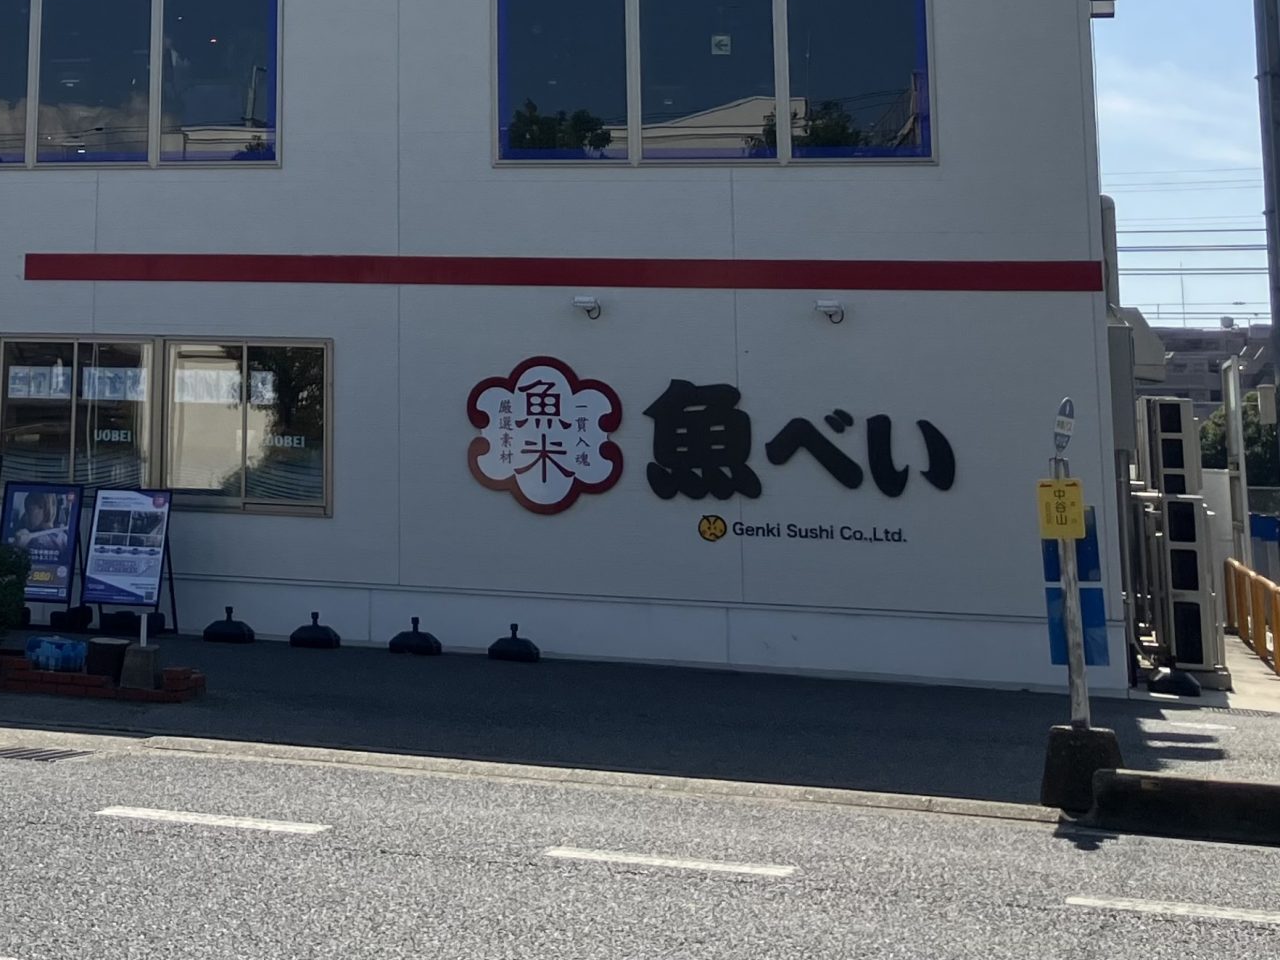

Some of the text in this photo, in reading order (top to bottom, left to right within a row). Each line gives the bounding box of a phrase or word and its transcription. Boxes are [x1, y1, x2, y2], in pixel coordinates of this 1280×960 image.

[94, 428, 132, 442] UOBEI
[498, 398, 515, 465] 厳選素材
[574, 404, 591, 468] 一貫入魂
[642, 378, 956, 500] 魚べい
[732, 521, 781, 538] Genki
[786, 523, 835, 540] Sushi
